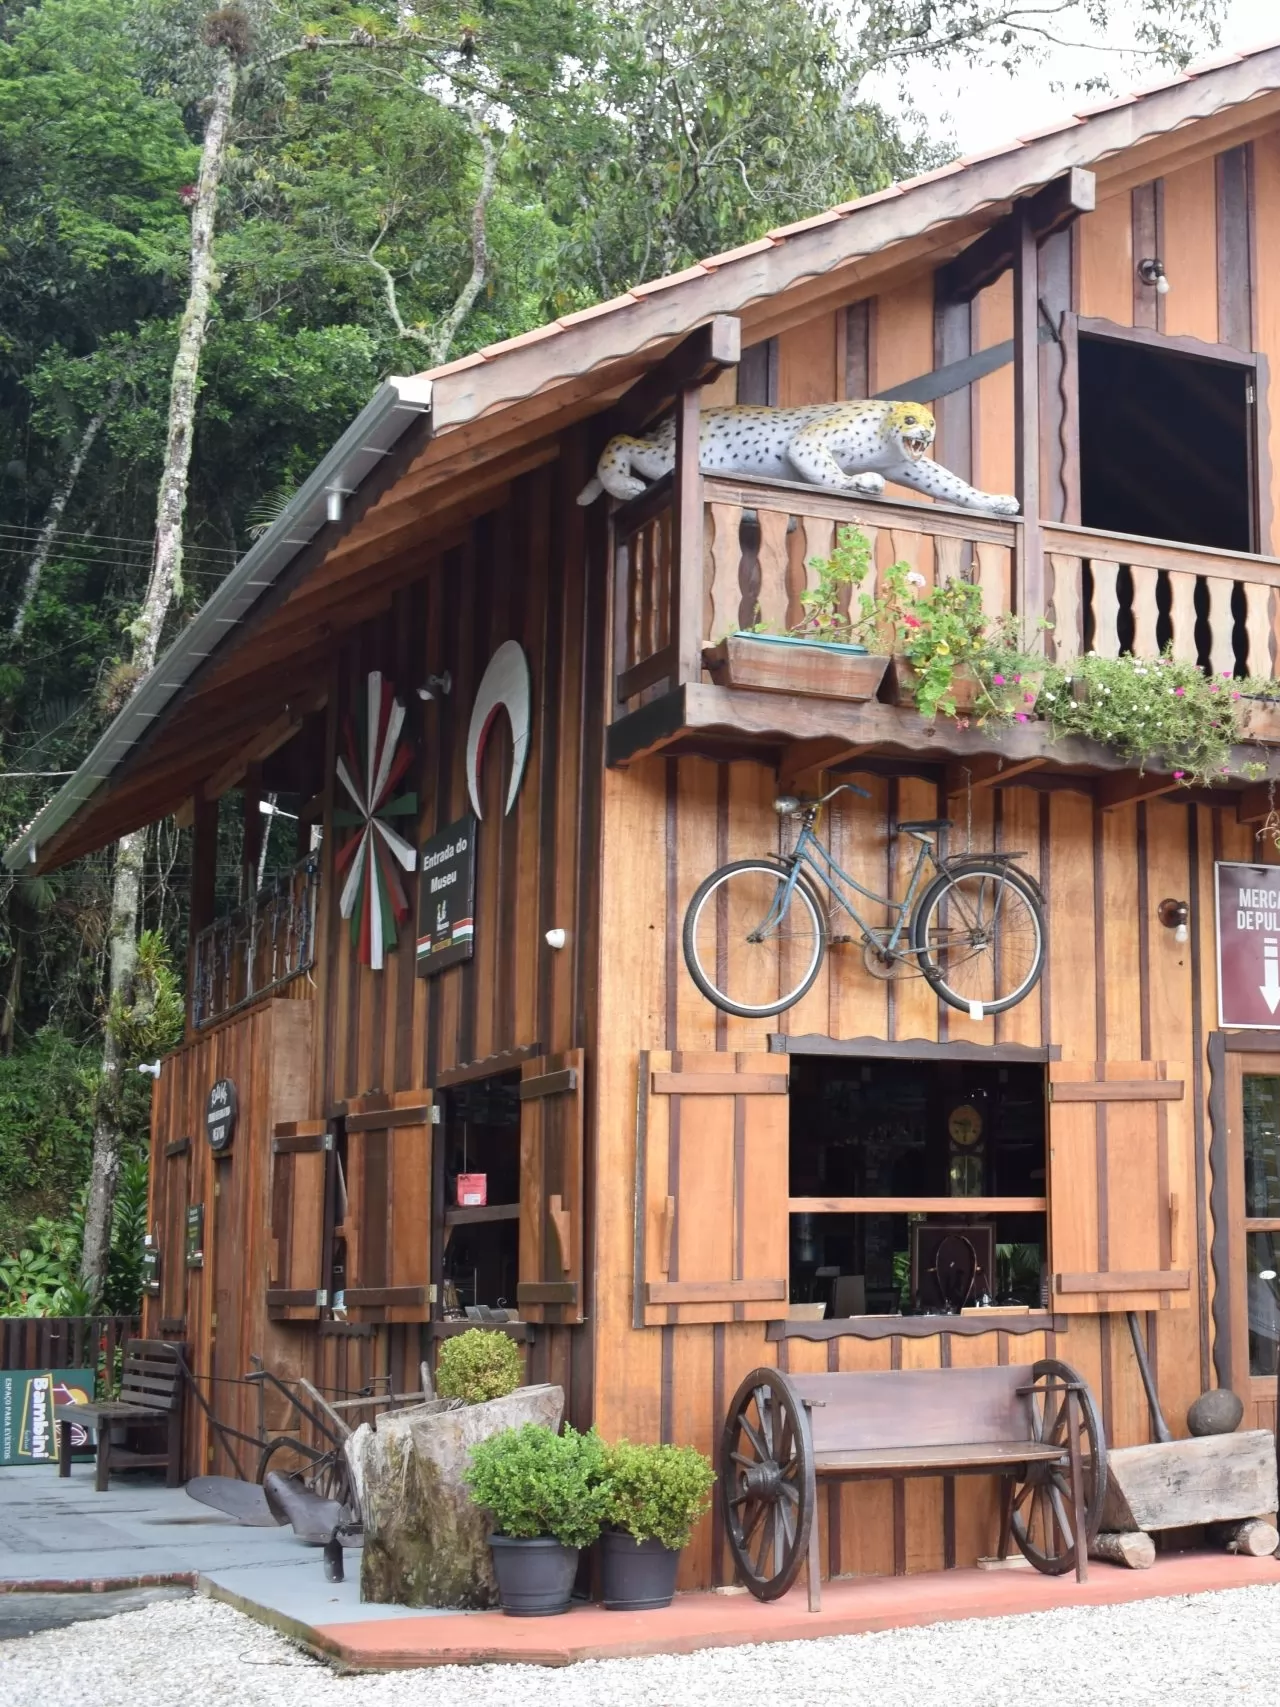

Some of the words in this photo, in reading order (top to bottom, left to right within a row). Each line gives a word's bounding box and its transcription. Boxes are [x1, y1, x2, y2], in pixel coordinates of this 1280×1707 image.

[423, 844, 455, 871] Entrada
[455, 837, 468, 854] do
[430, 870, 457, 894] Museu
[4, 1377, 12, 1405] ESPAÇO
[4, 1406, 12, 1426] PARA
[32, 1377, 50, 1458] Bambini
[4, 1427, 12, 1460] EVENTOS
